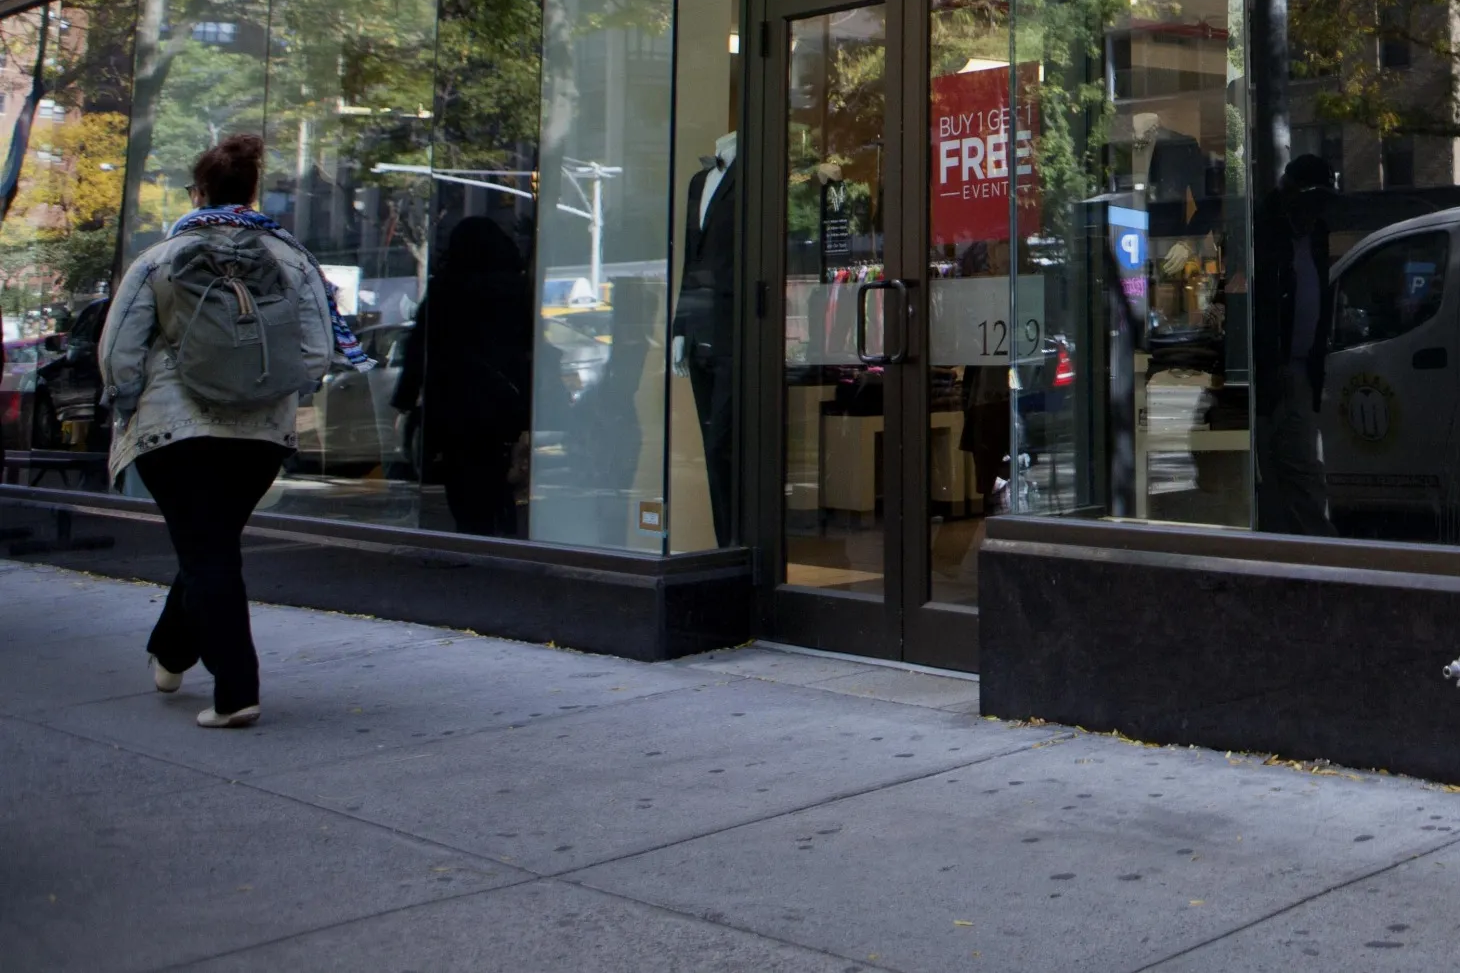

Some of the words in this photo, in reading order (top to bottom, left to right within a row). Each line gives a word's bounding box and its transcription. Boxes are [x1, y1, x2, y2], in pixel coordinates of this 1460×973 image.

[940, 112, 974, 137] BUY
[940, 130, 1032, 184] FREE
[963, 181, 1008, 200] EVENT
[978, 318, 1040, 356] 129
